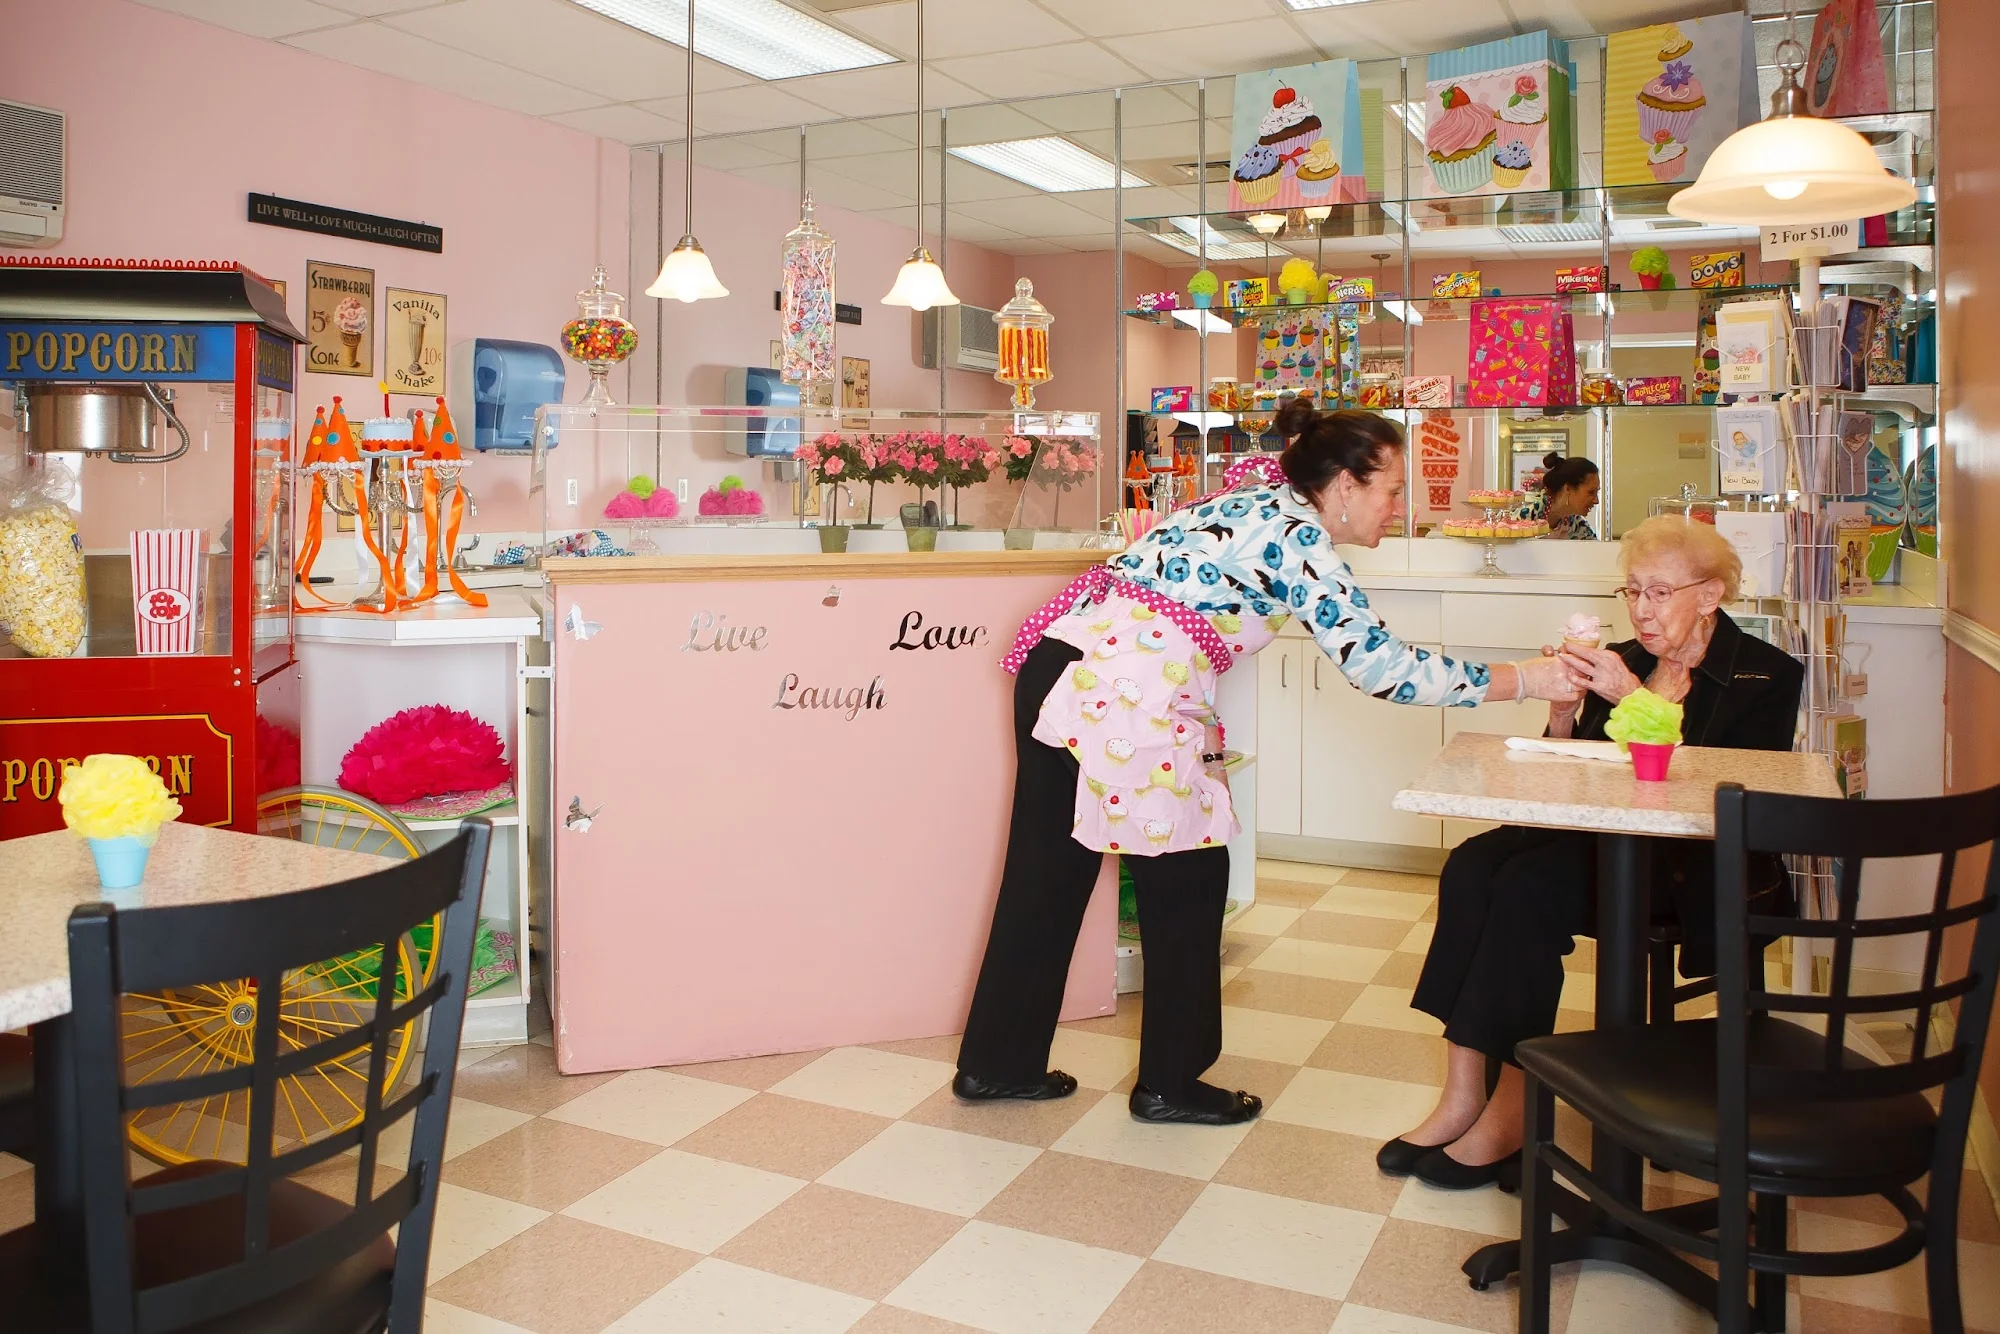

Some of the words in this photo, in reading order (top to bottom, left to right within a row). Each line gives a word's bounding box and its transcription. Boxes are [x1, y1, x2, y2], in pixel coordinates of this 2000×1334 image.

[257, 203, 280, 217] LIVE
[282, 208, 309, 223] WELL
[315, 215, 341, 228] LOVE
[343, 220, 372, 234] MUCH
[378, 226, 409, 240] LAUGH
[410, 231, 439, 245] OFTEN
[1770, 232, 1778, 244] 2
[1782, 231, 1807, 243] For
[1810, 224, 1848, 240] $1.00
[1692, 256, 1739, 281] DOTS
[1557, 276, 1582, 284] Mike
[392, 299, 440, 321] Vanilla
[6, 331, 199, 373] POPCORN
[394, 368, 435, 388] Shake
[1406, 378, 1440, 396] WHPPERS
[1654, 381, 1671, 391] CAPS
[1733, 373, 1751, 381] BABY
[1723, 475, 1739, 484] New
[150, 591, 174, 606] POP
[680, 609, 768, 653] Live
[888, 610, 989, 652] Love
[771, 672, 888, 722] Laugh
[2, 754, 195, 802] PORN
